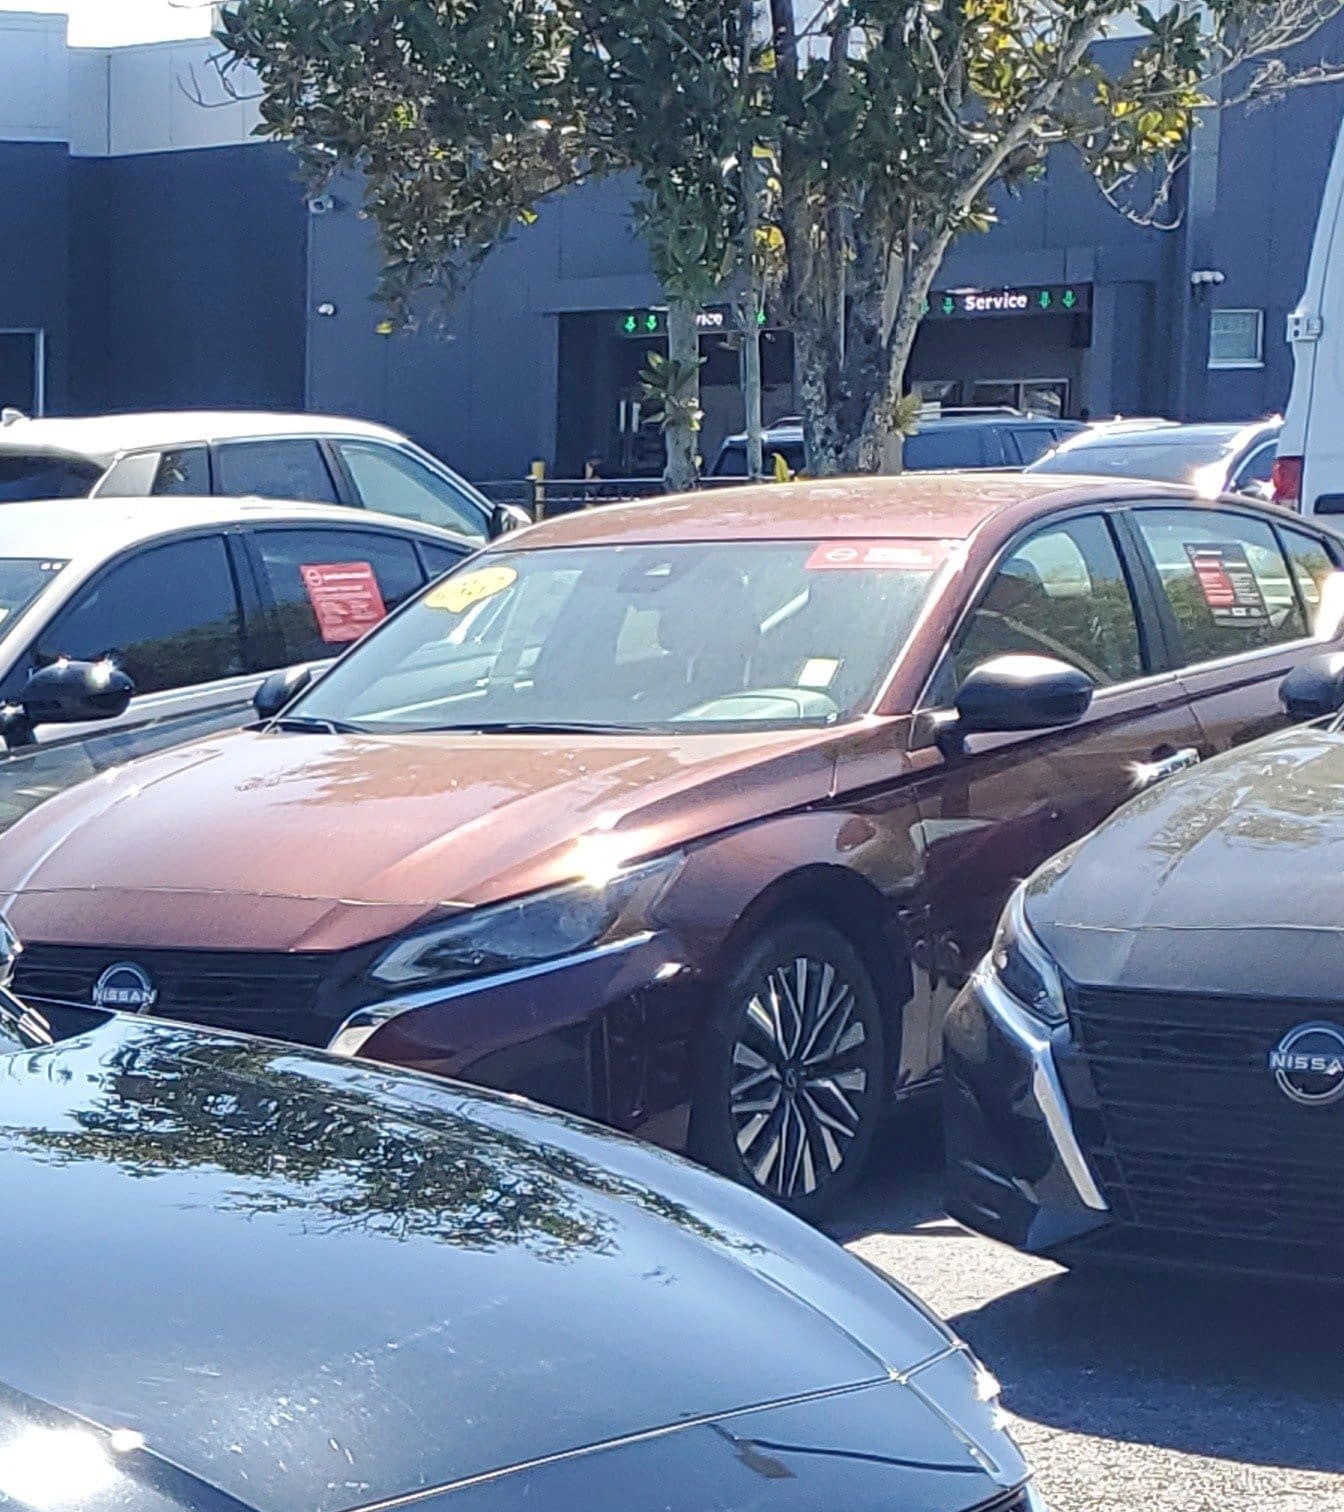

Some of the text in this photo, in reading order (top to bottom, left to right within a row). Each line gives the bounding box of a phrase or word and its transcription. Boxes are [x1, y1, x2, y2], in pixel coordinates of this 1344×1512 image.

[965, 291, 1028, 311] Service
[92, 987, 157, 1003] NISSAN
[1270, 1051, 1344, 1073] NISSA
